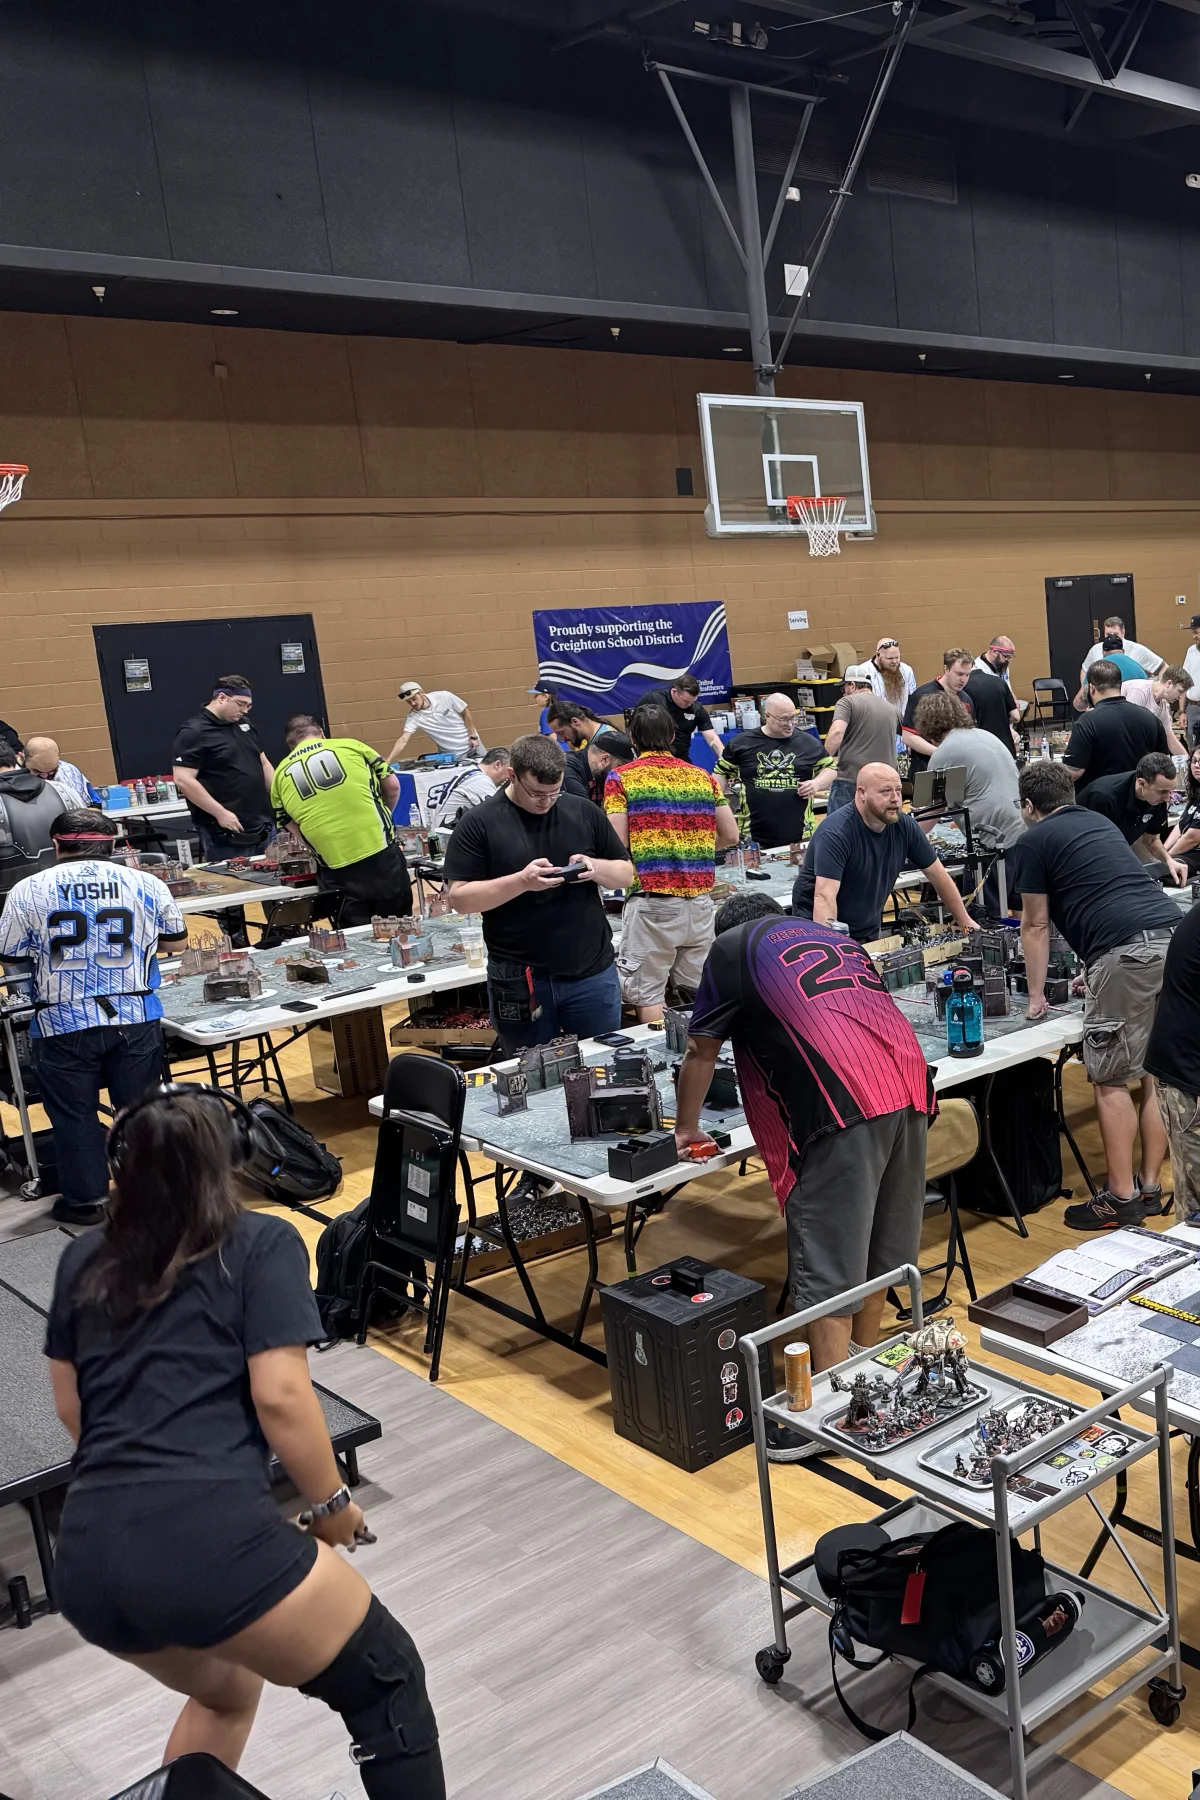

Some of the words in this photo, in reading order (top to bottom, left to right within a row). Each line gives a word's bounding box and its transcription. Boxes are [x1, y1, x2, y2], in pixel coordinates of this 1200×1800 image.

[549, 624, 593, 637] Proudly
[595, 621, 655, 634] supporting
[656, 618, 673, 630] the
[550, 638, 606, 653] Creighton
[607, 635, 644, 649] School
[645, 633, 684, 646] District
[289, 742, 323, 760] WINNIE
[284, 748, 347, 801] 10
[59, 882, 120, 900] YOSHI
[47, 907, 134, 972] 23
[779, 941, 891, 1002] 23
[1141, 1298, 1181, 1315] Deployment
